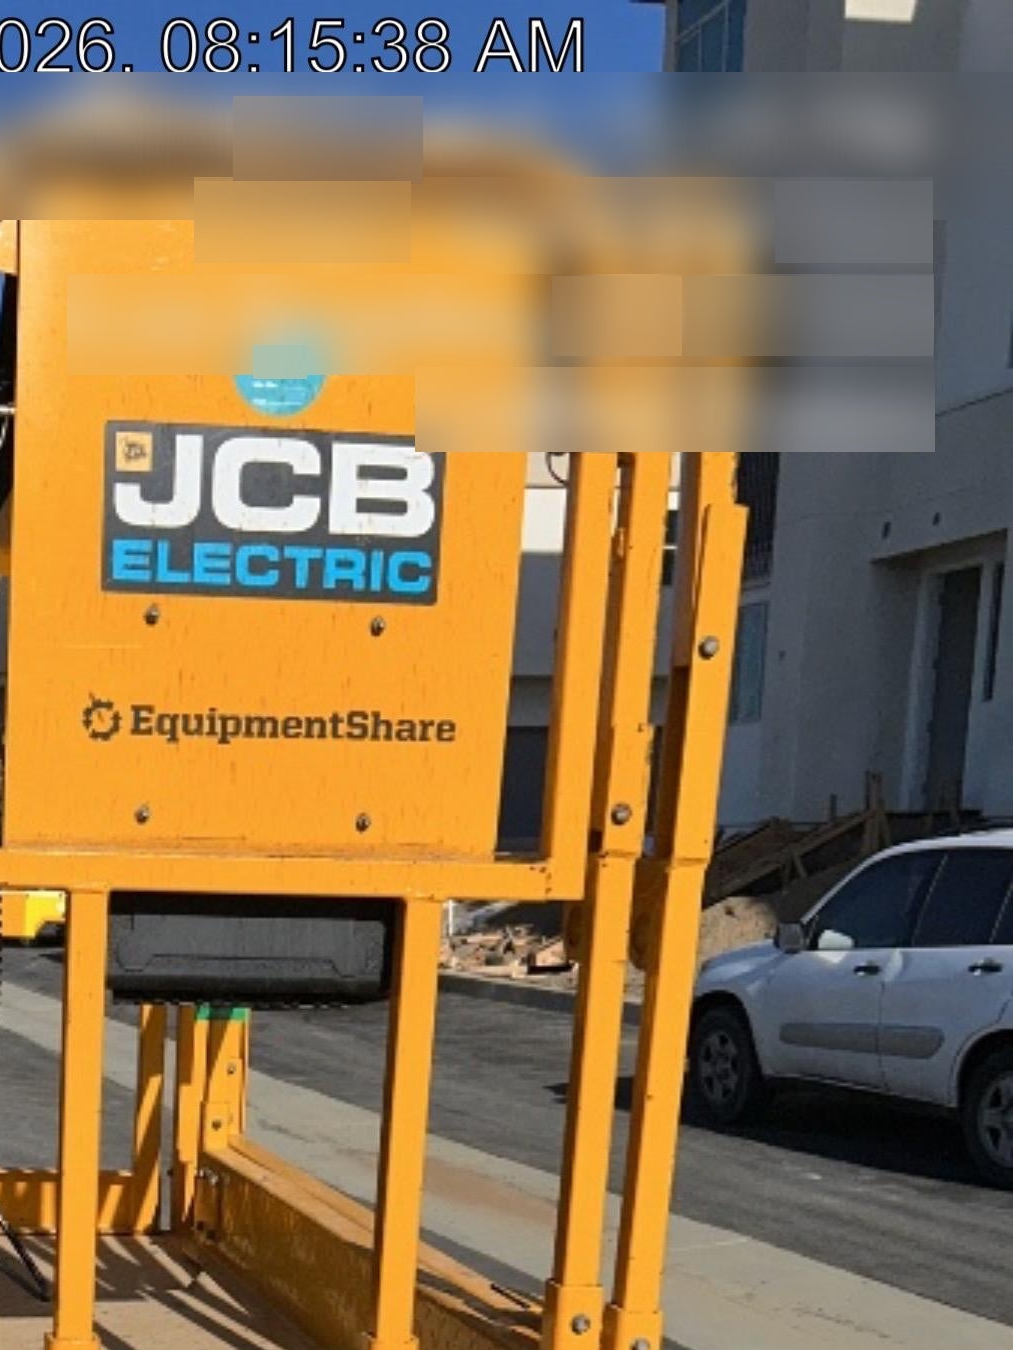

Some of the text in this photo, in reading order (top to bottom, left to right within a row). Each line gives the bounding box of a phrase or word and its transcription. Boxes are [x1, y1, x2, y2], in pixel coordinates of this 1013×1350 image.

[113, 434, 435, 537] JCB
[111, 539, 432, 593] ELECTRIC
[130, 704, 456, 744] EquipmentShare
